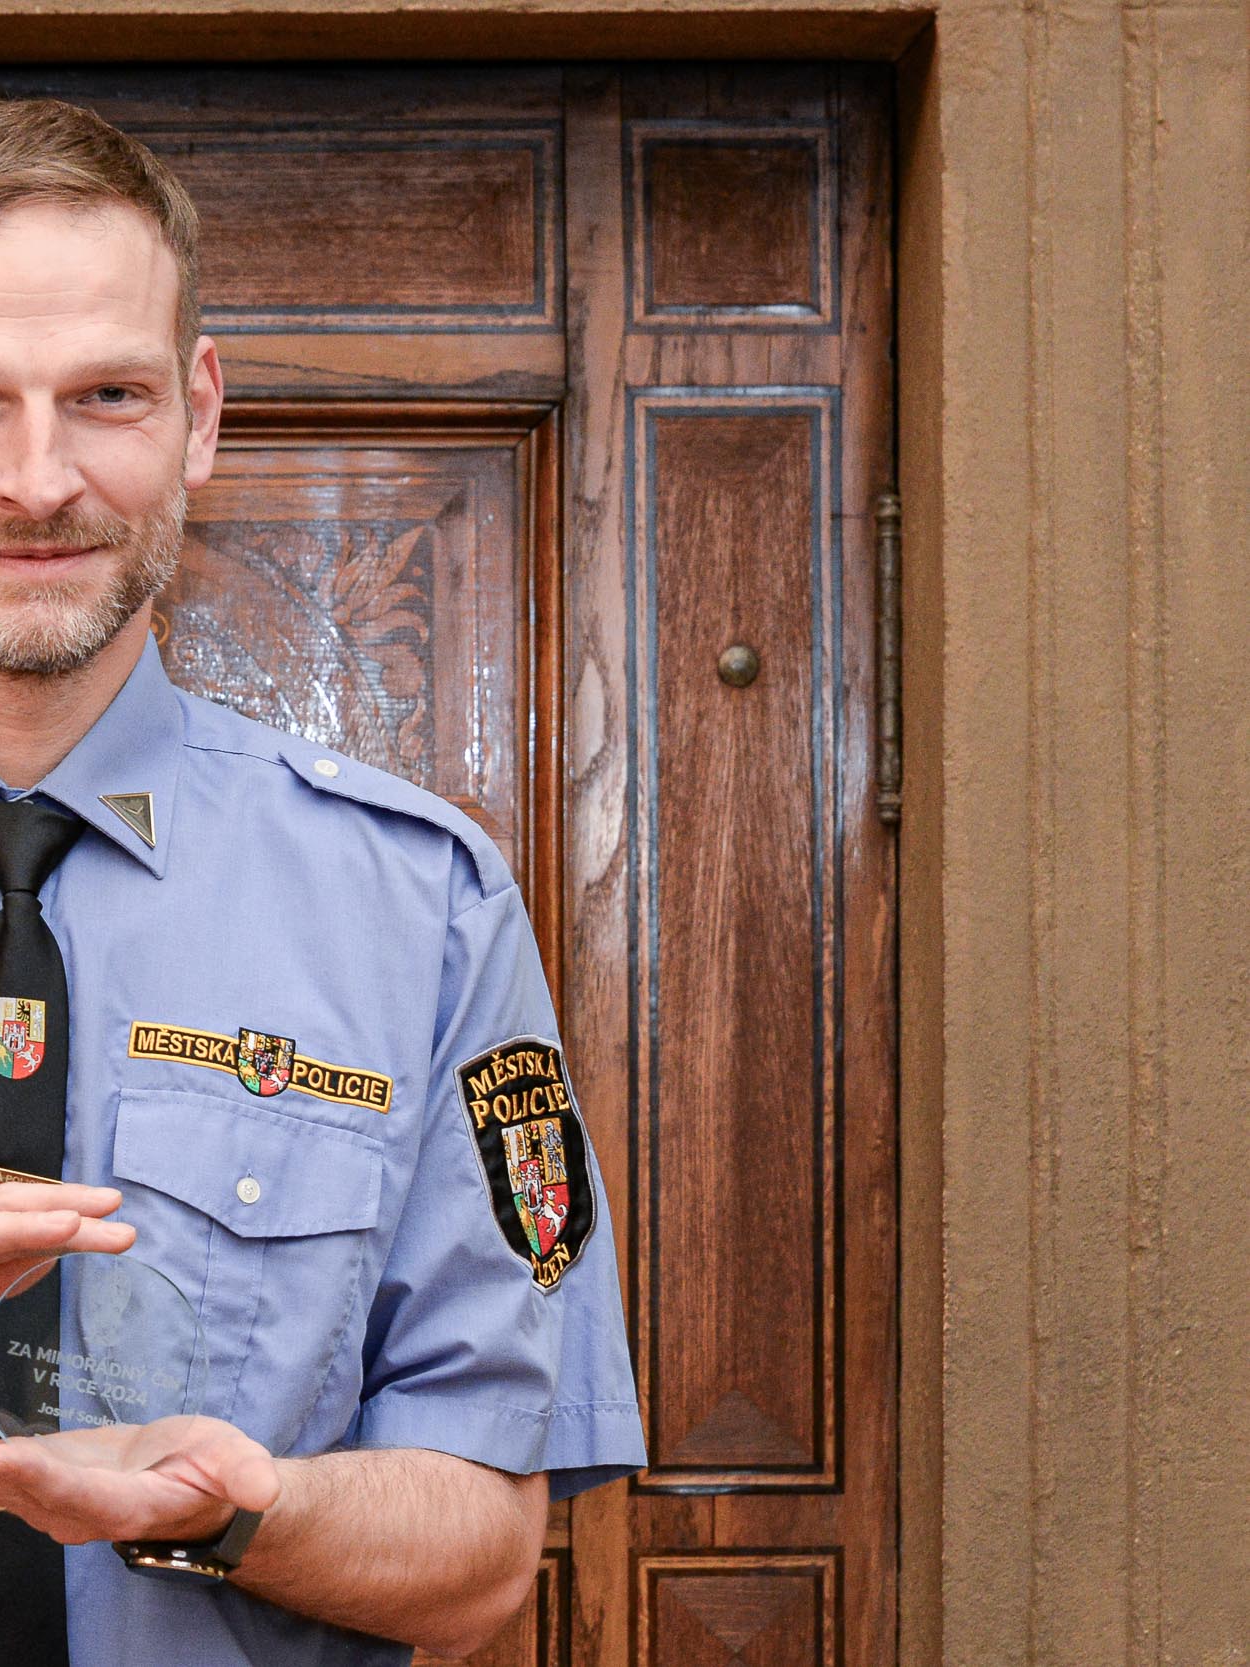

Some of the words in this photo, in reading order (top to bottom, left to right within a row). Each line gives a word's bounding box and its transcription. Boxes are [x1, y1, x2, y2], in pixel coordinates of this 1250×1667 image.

[137, 1029, 236, 1066] MĚSTSKÁ
[292, 1063, 384, 1102] POLICIE
[468, 1049, 559, 1099] MĚSTSKÁ
[470, 1083, 570, 1129] POLICIE
[7, 1340, 31, 1359] ZA
[34, 1368, 47, 1384] V
[100, 1383, 148, 1406] 2024
